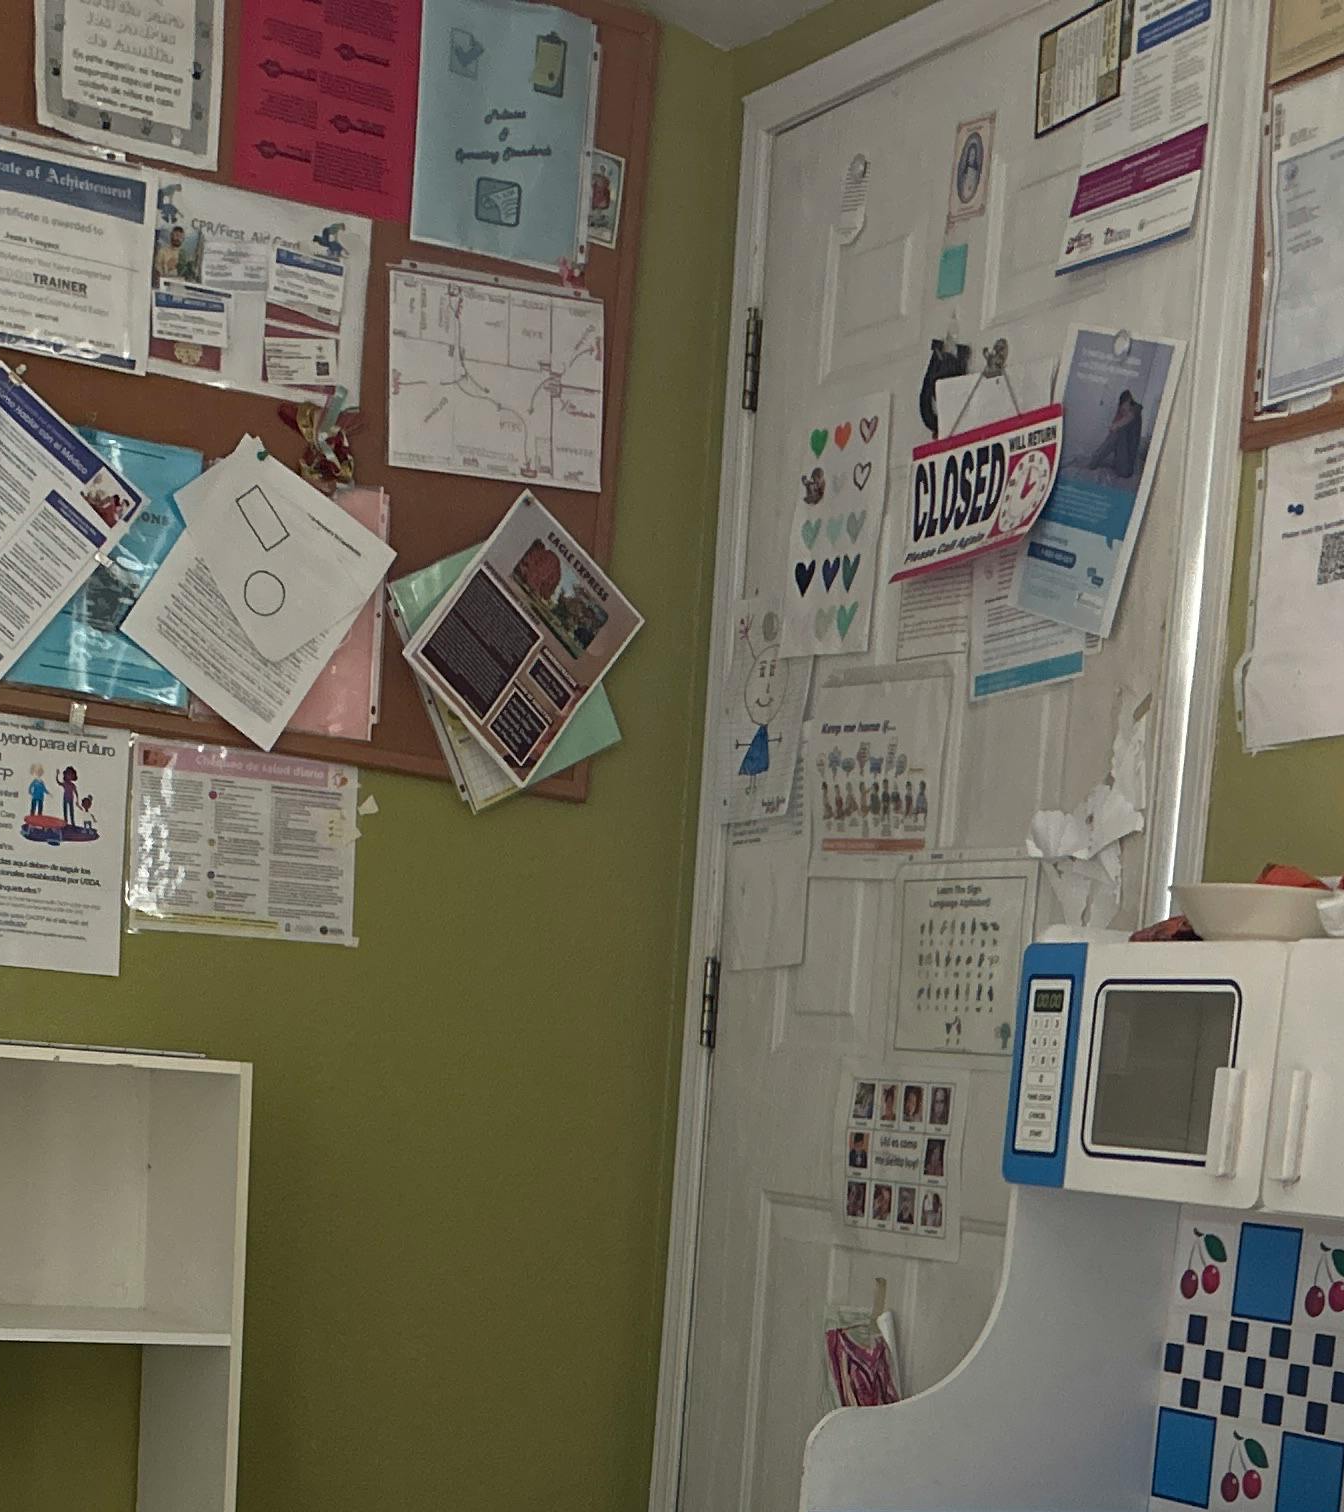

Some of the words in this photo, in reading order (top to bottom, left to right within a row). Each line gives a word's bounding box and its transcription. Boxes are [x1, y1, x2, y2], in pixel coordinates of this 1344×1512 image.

[25, 165, 42, 181] of
[45, 167, 132, 201] Achievement
[191, 218, 245, 240] CPR/First
[252, 231, 271, 245] Aid
[1009, 433, 1027, 452] WILL
[1027, 424, 1057, 449] RETURN
[913, 441, 1006, 543] CLOSED
[904, 546, 937, 565] Please
[937, 539, 958, 555] Call
[956, 532, 985, 550] Again
[547, 531, 575, 566] EAGLE
[571, 558, 610, 603] EXPRESS
[821, 721, 842, 736] Keep
[843, 722, 857, 733] me
[857, 720, 881, 734] home
[39, 738, 65, 752] para
[66, 739, 77, 752] el
[78, 740, 116, 757] Futuro
[261, 763, 291, 776] salud
[292, 765, 325, 780] diario
